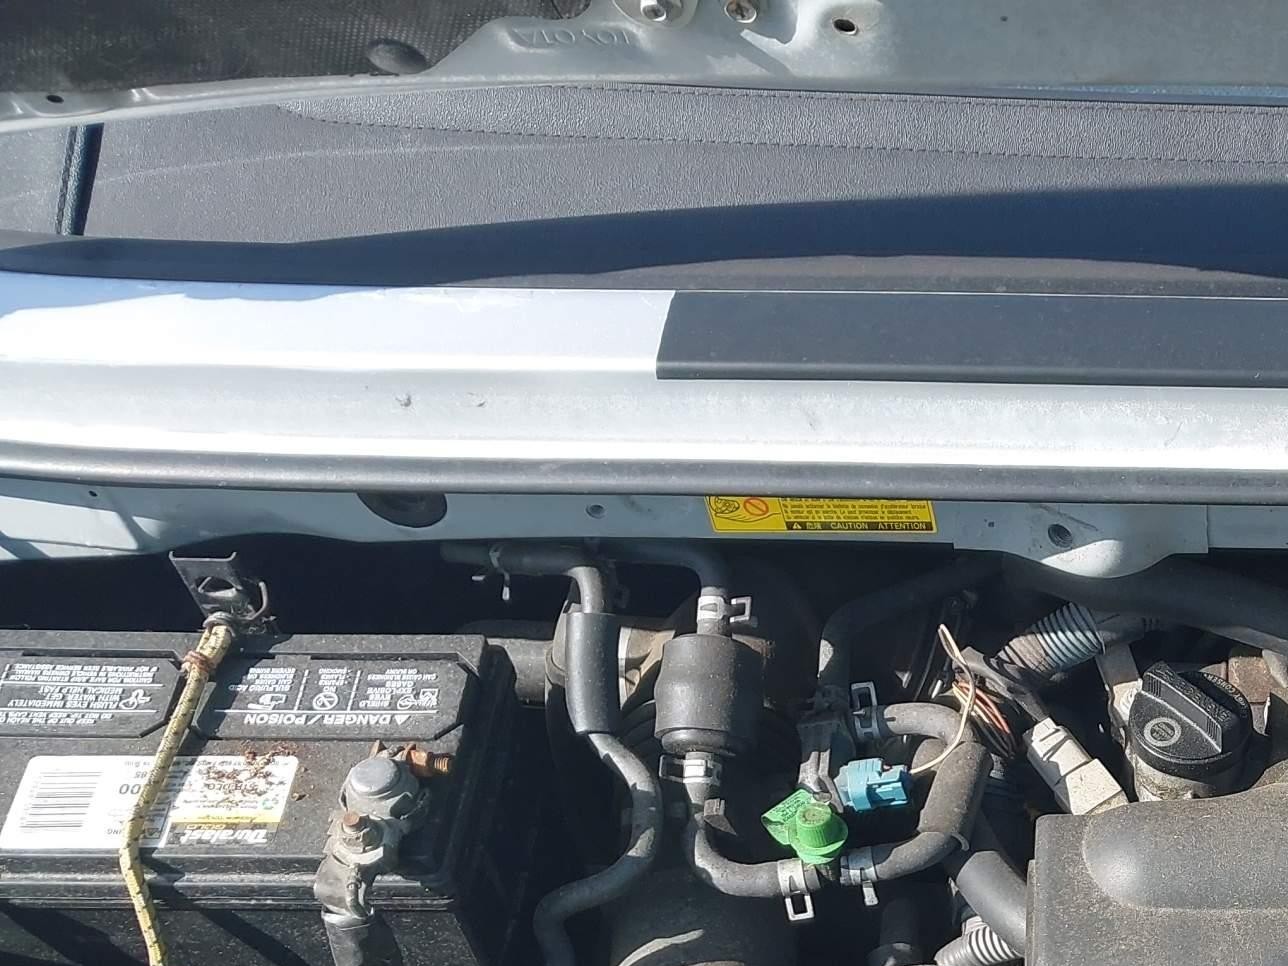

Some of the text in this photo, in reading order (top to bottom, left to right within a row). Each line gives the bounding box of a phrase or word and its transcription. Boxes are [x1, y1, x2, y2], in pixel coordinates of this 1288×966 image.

[830, 522, 868, 530] CAUTION
[878, 522, 926, 530] ATTENTION
[7, 700, 64, 708] IMMEDIATELY
[179, 829, 268, 844] Duralast
